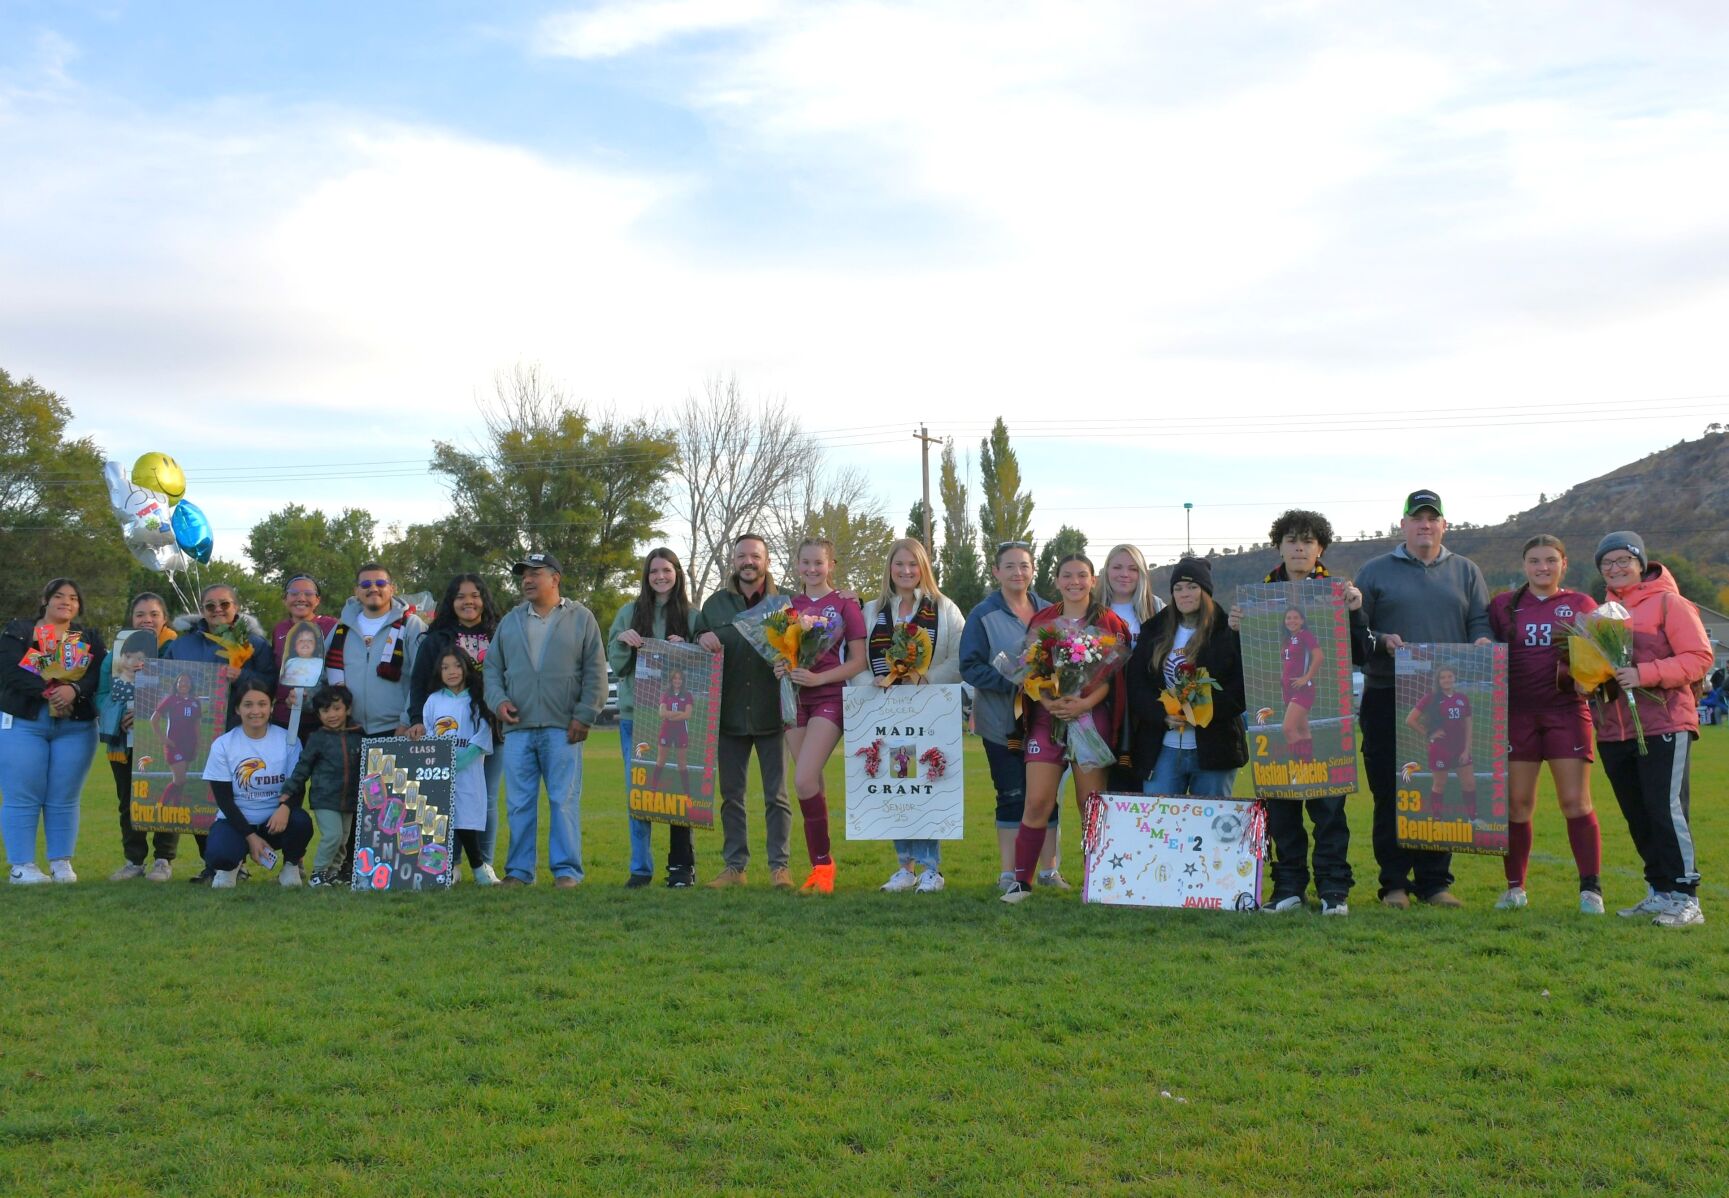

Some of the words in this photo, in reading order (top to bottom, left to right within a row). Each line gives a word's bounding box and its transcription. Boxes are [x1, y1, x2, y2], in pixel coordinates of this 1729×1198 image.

[1524, 623, 1552, 647] 33
[1331, 581, 1354, 752] RIVERHAWKS
[1448, 707, 1461, 719] 33
[875, 726, 924, 737] MADI
[1491, 645, 1506, 817] RIVERHAWKS
[409, 745, 436, 754] CLASS
[1255, 735, 1269, 757] 2
[425, 757, 437, 766] OF
[1328, 756, 1354, 768] Senior
[255, 773, 286, 786] TDHS
[415, 767, 450, 781] 2025
[631, 767, 647, 786] 16
[132, 780, 149, 799] 18
[867, 784, 933, 795] GRANT
[1305, 787, 1328, 797] Girls
[630, 788, 688, 817] GRANT
[1115, 801, 1150, 815] WAY
[1159, 803, 1180, 816] TO
[1191, 805, 1215, 818] GO
[1397, 789, 1422, 812] 33
[130, 801, 155, 823] Cruz
[156, 801, 191, 825] Torres
[1397, 815, 1472, 843] Benjamin
[363, 815, 424, 890] SENIOR
[1181, 895, 1223, 911] JAMIE
